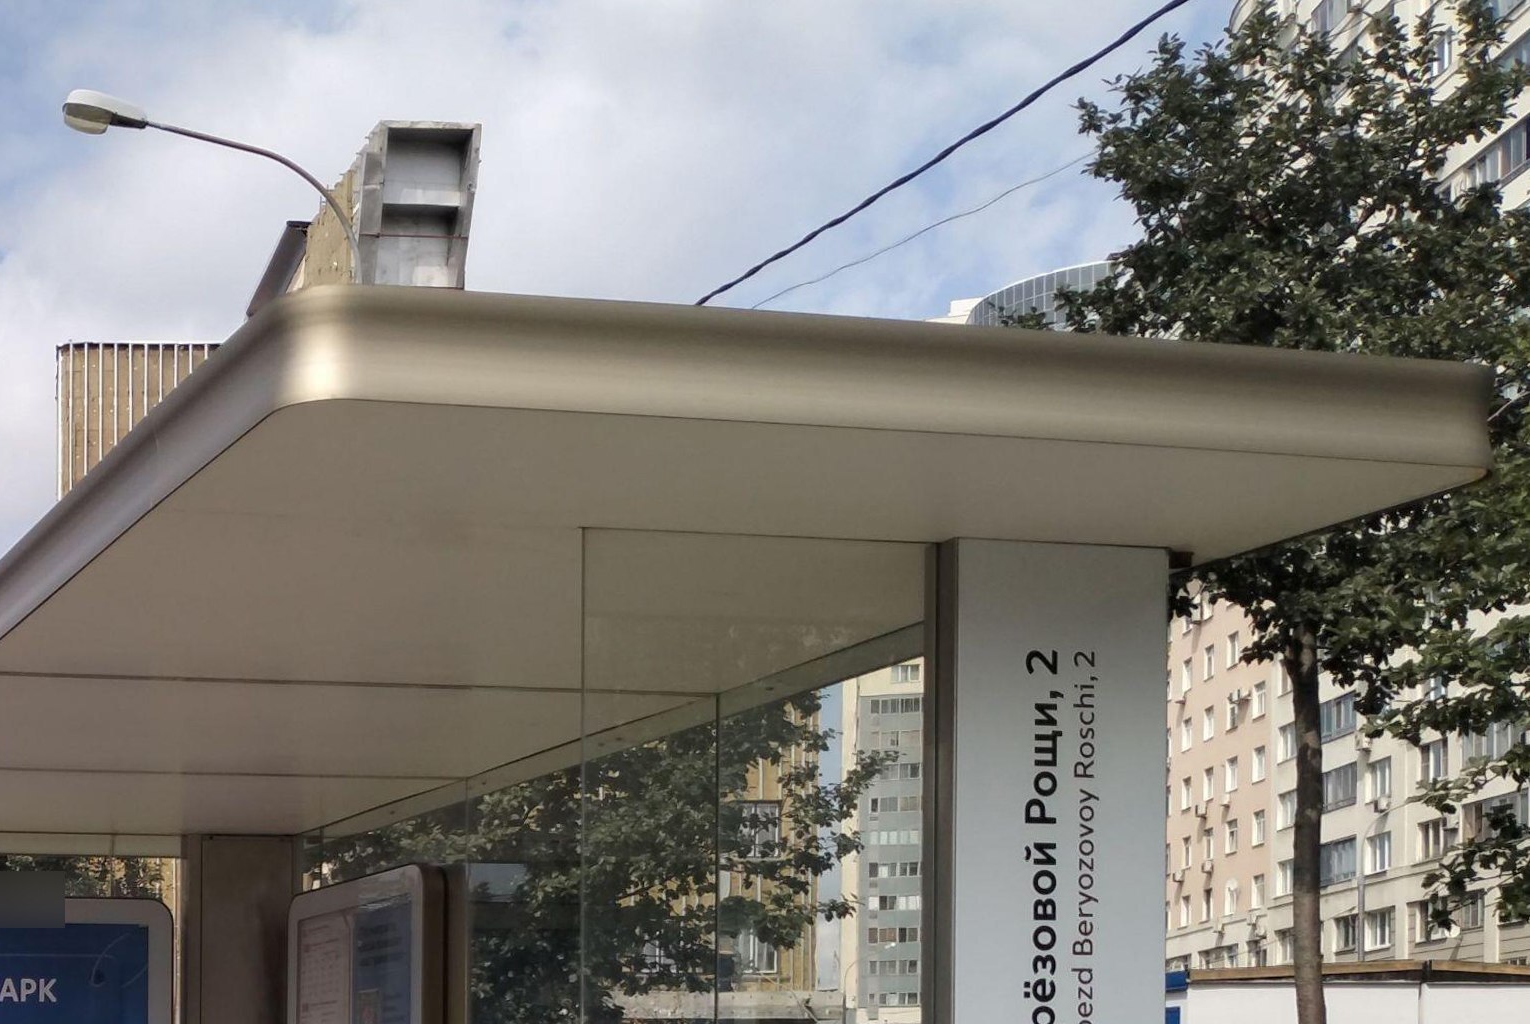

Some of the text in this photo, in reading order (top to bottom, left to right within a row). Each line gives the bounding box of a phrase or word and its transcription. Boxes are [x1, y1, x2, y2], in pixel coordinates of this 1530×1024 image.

[1025, 649, 1058, 675] 2
[1073, 651, 1095, 668] 2
[1024, 690, 1064, 824] Рощи,
[1073, 675, 1099, 778] Roschi,
[1072, 788, 1099, 956] Beryozovoy
